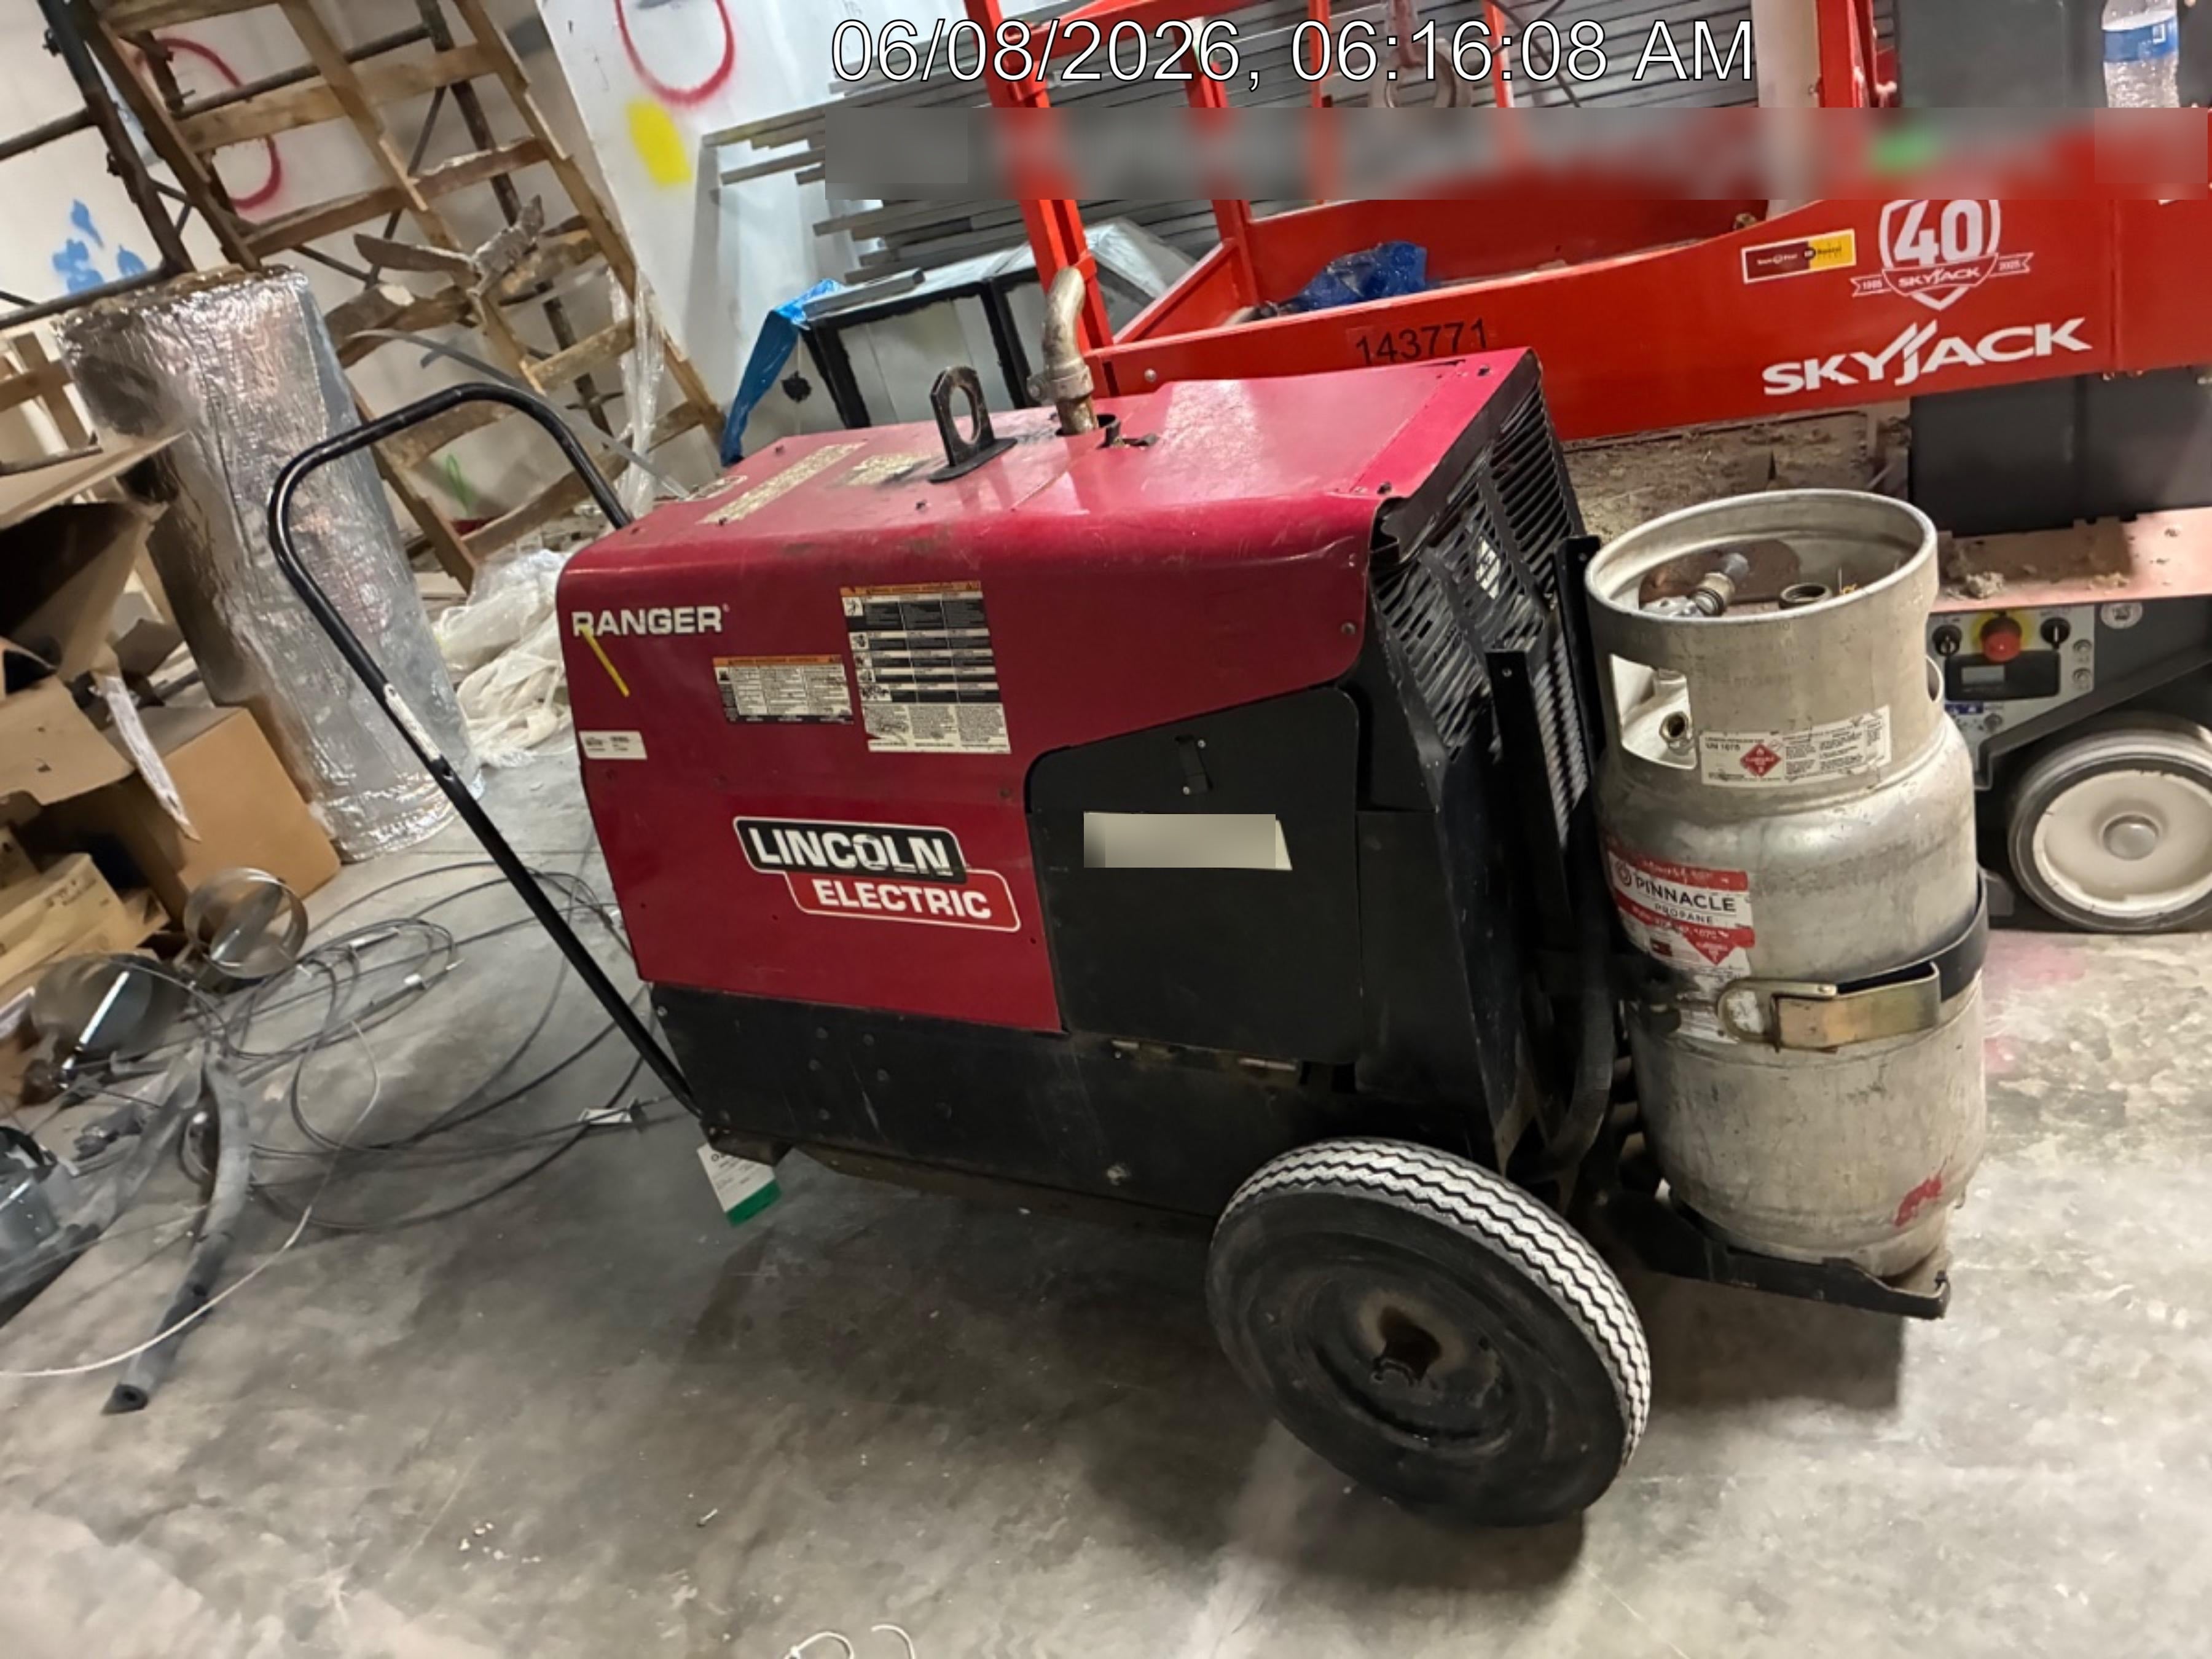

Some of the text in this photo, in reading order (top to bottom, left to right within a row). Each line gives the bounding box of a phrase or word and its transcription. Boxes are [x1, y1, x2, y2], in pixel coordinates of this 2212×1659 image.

[1894, 200, 1983, 267] 40
[1897, 266, 1980, 288] SKYJACK
[1355, 318, 1486, 365] 143771
[1762, 318, 2093, 394] SKYJACK
[571, 606, 722, 637] RANGER
[748, 827, 954, 877] LINCOLN
[812, 879, 992, 919] ELECTRIC
[1636, 876, 1737, 912] PINNACLE
[1654, 903, 1714, 925] PROPANE
